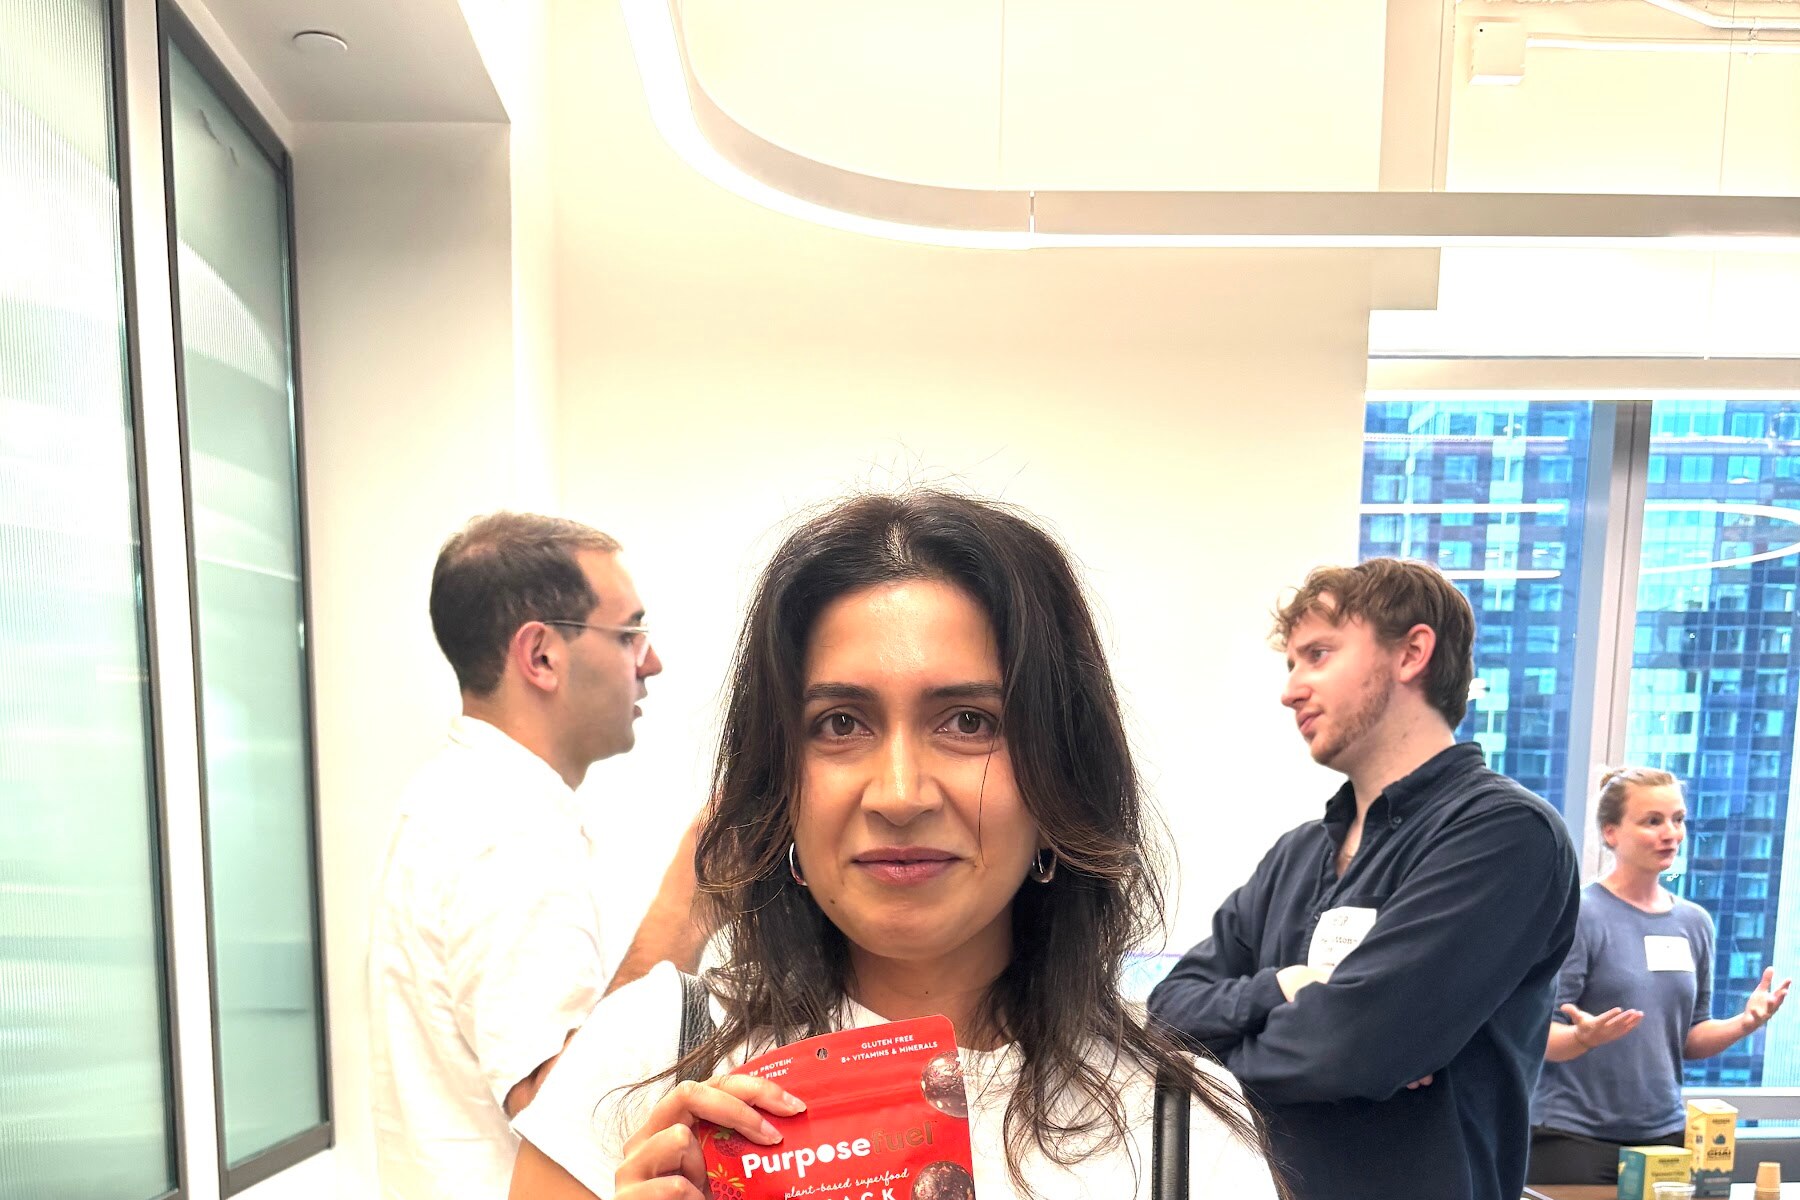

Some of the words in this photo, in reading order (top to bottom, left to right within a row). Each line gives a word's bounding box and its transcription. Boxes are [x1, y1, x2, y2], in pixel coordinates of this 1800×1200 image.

[852, 1049, 889, 1061] VITAMINS
[899, 1041, 938, 1054] MINERALS
[861, 1038, 893, 1050] GLUTEN
[894, 1034, 914, 1044] FREE
[855, 1167, 909, 1188] superfood
